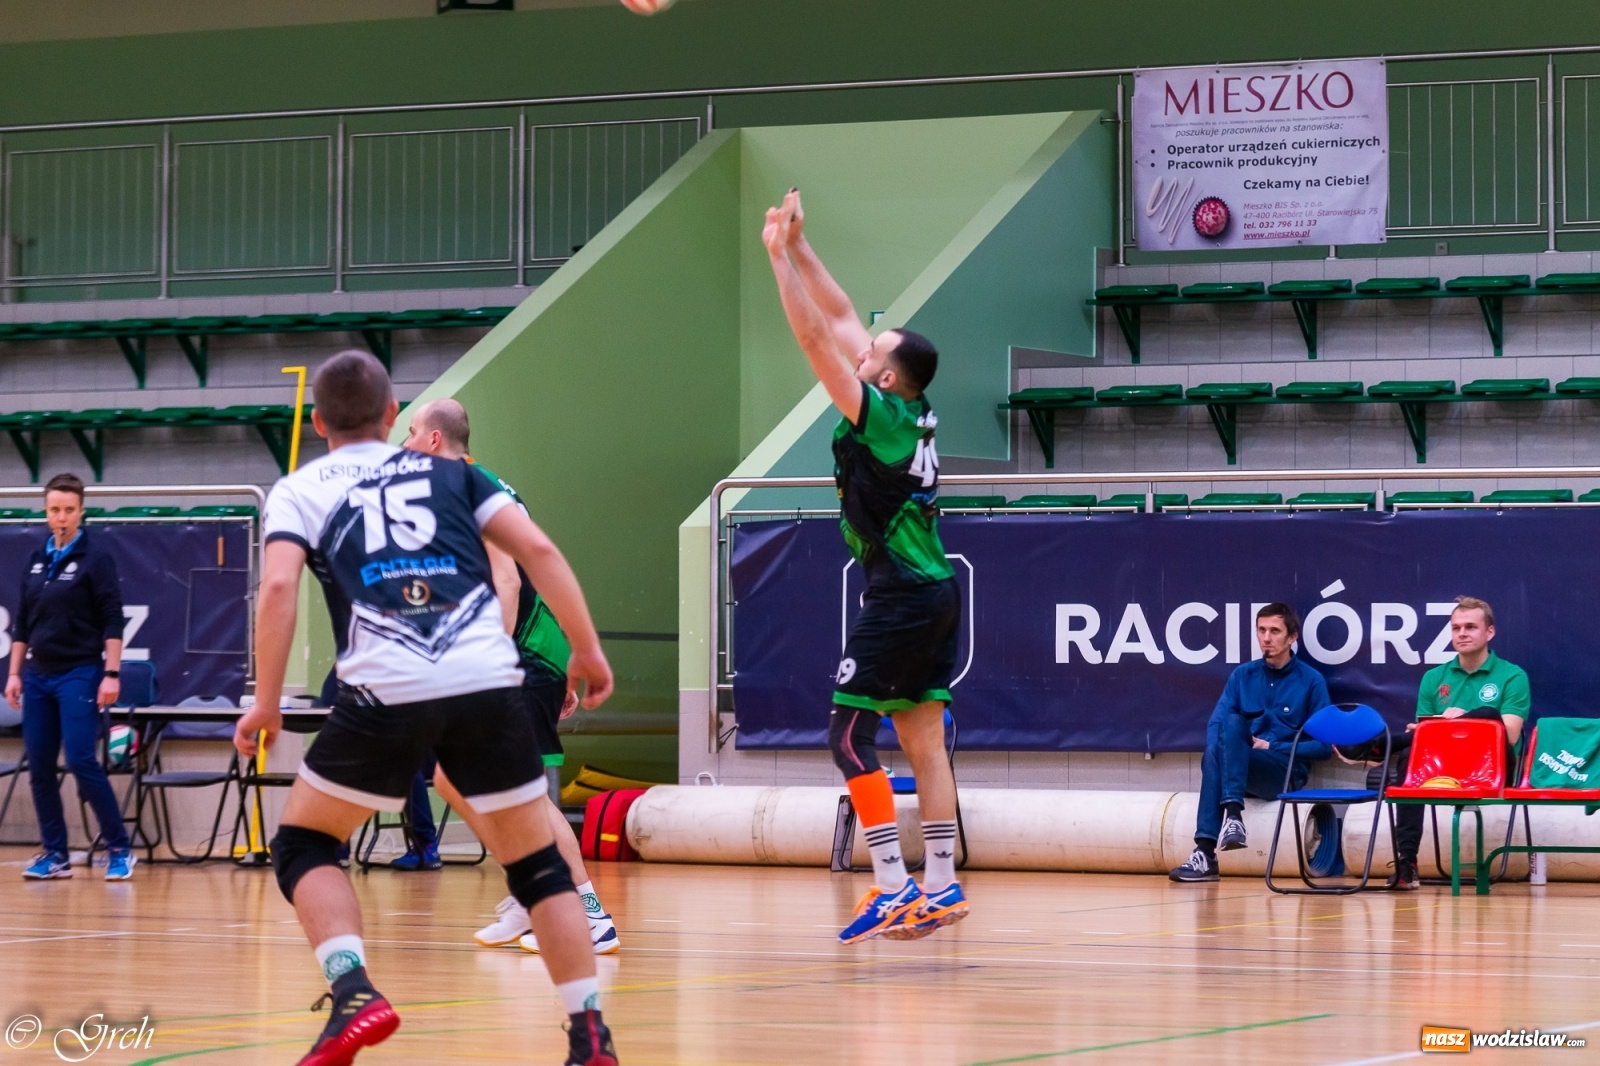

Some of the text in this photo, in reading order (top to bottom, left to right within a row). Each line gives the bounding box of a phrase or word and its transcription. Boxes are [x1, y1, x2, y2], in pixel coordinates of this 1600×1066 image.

[1164, 71, 1354, 116] MIESZKO
[1175, 128, 1219, 138] poszukuje
[1221, 125, 1277, 136] pracowników
[1293, 122, 1344, 132] stanowiska:
[1167, 136, 1381, 157] Operator urządzeń cukierniczych
[1167, 154, 1318, 170] Pracownik produkcyjny
[1243, 175, 1370, 191] Czekamy na Ciebie!
[1243, 202, 1273, 210] Mieszko
[1275, 201, 1288, 209] BIS
[1243, 211, 1271, 219] 47-400
[1272, 210, 1302, 219] Racibórz
[1317, 207, 1366, 217] Starowiejska
[1368, 207, 1379, 215] 75
[1243, 219, 1317, 229] tel. 032 796 11 33
[1243, 229, 1311, 240] www.mieszko.pl
[347, 477, 437, 554] 15
[1055, 578, 1460, 665] RACIÓRZ
